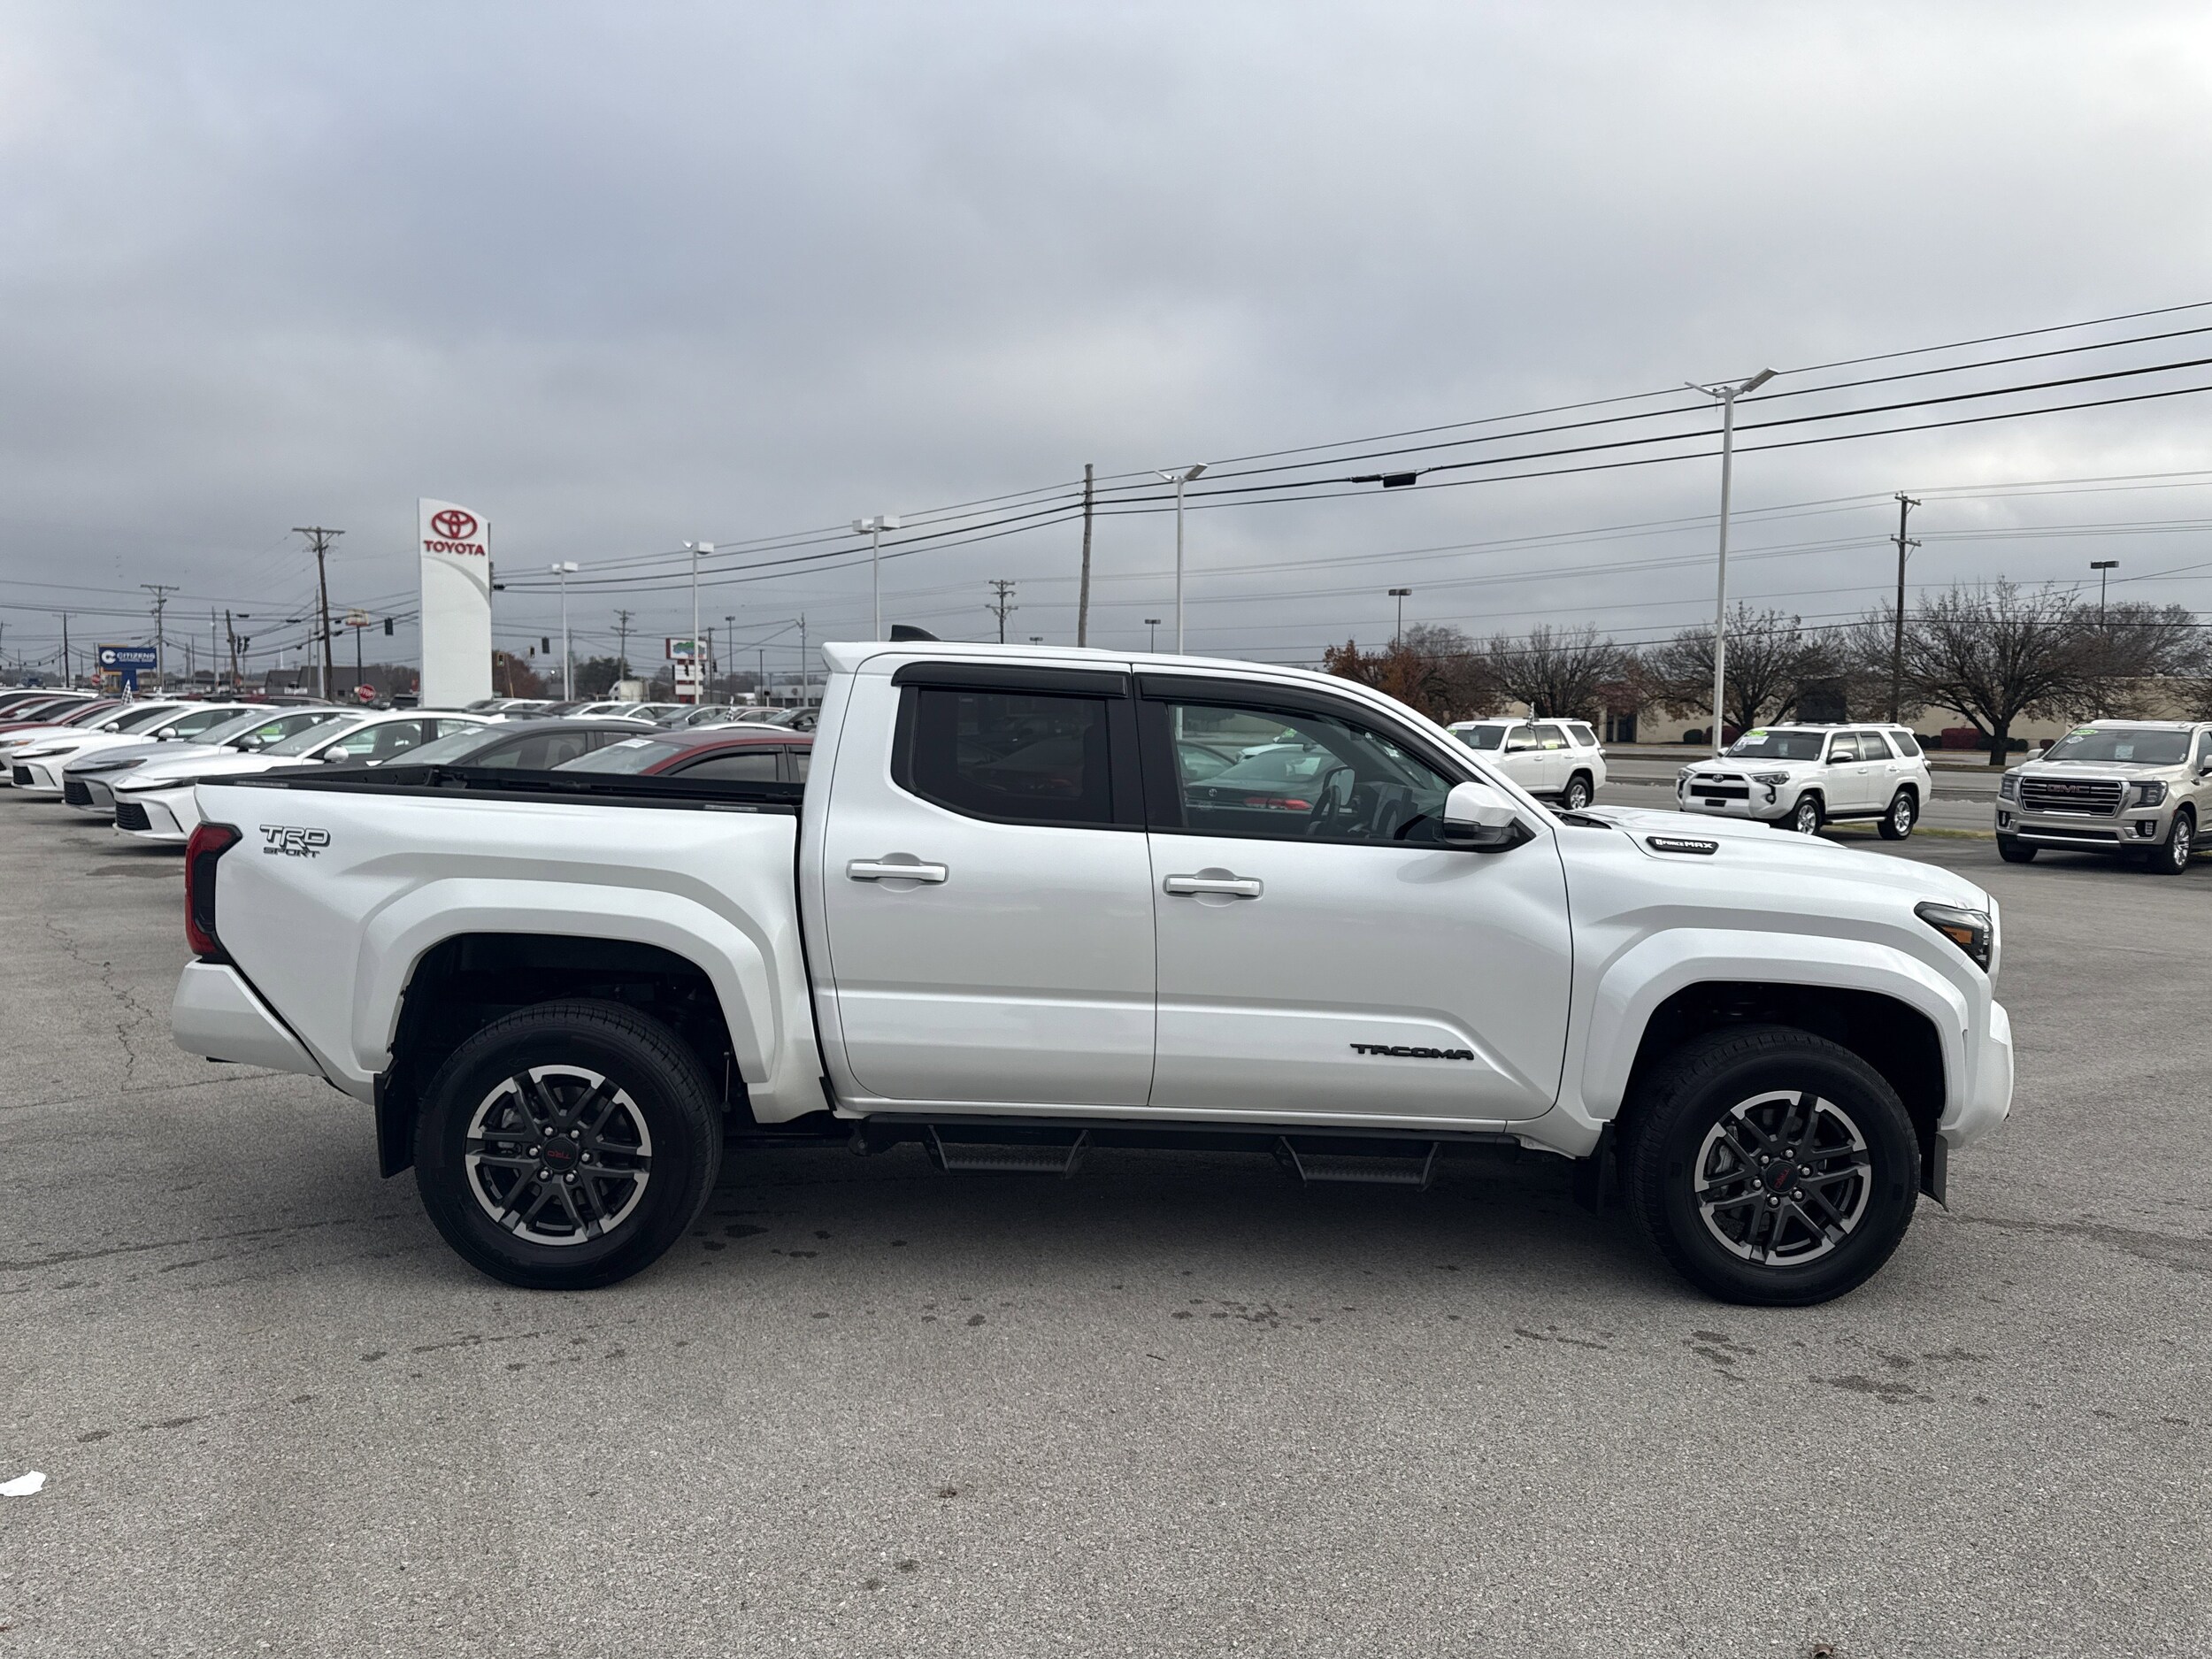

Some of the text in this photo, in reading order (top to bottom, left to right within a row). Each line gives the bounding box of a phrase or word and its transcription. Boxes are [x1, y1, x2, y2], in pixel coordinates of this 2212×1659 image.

[424, 540, 486, 557] TOYOTA
[2047, 783, 2089, 794] GMC
[259, 824, 331, 849] TRD
[263, 847, 320, 858] SPORT
[1349, 1043, 1474, 1061] TACOMA
